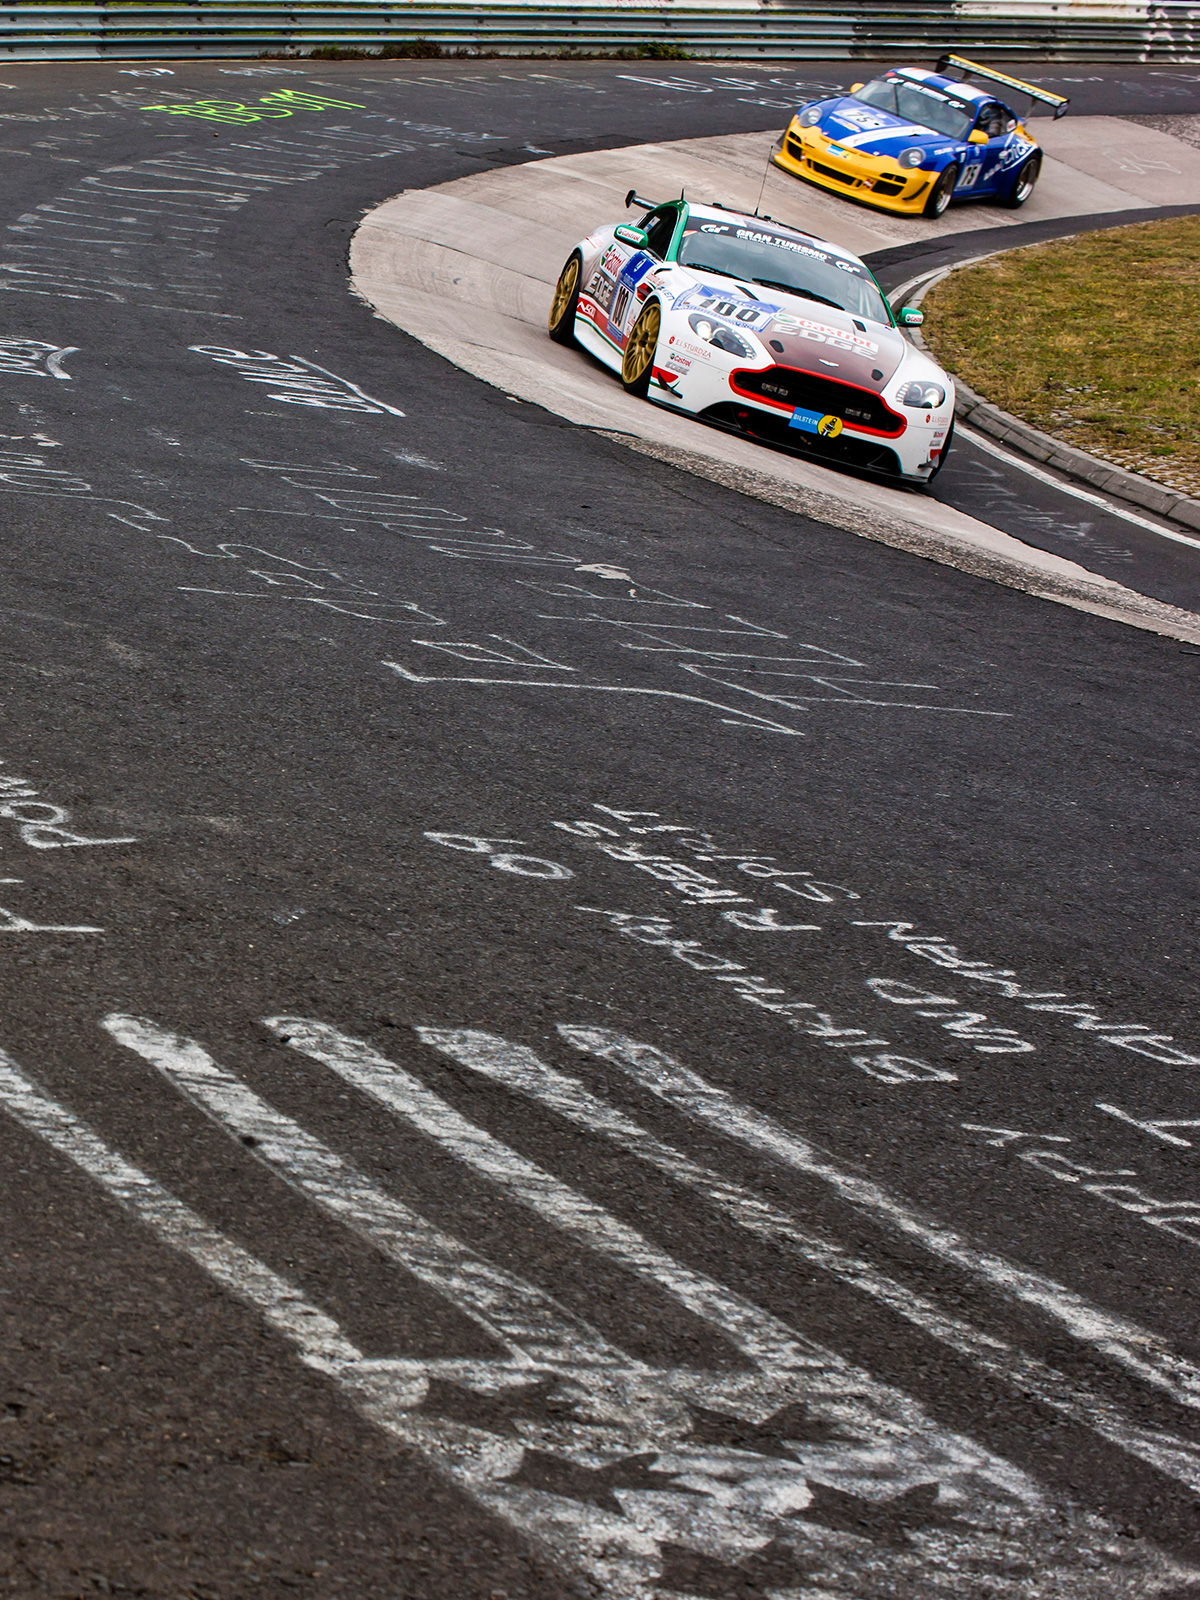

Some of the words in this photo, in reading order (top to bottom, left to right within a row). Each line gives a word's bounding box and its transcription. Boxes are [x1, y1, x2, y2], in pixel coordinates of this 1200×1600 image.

[960, 165, 978, 185] 75
[621, 230, 642, 242] Castrol
[736, 229, 772, 244] GRAN
[773, 237, 828, 260] TURISMO
[584, 273, 614, 307] EDGE
[771, 323, 880, 361] EDGE
[799, 319, 872, 349] Castrol
[674, 355, 692, 367] Castrol
[683, 342, 712, 358] STURDZA
[793, 413, 819, 426] BILSTEIN
[574, 905, 959, 1084] BIRTHDAY
[864, 976, 1037, 1053] UND
